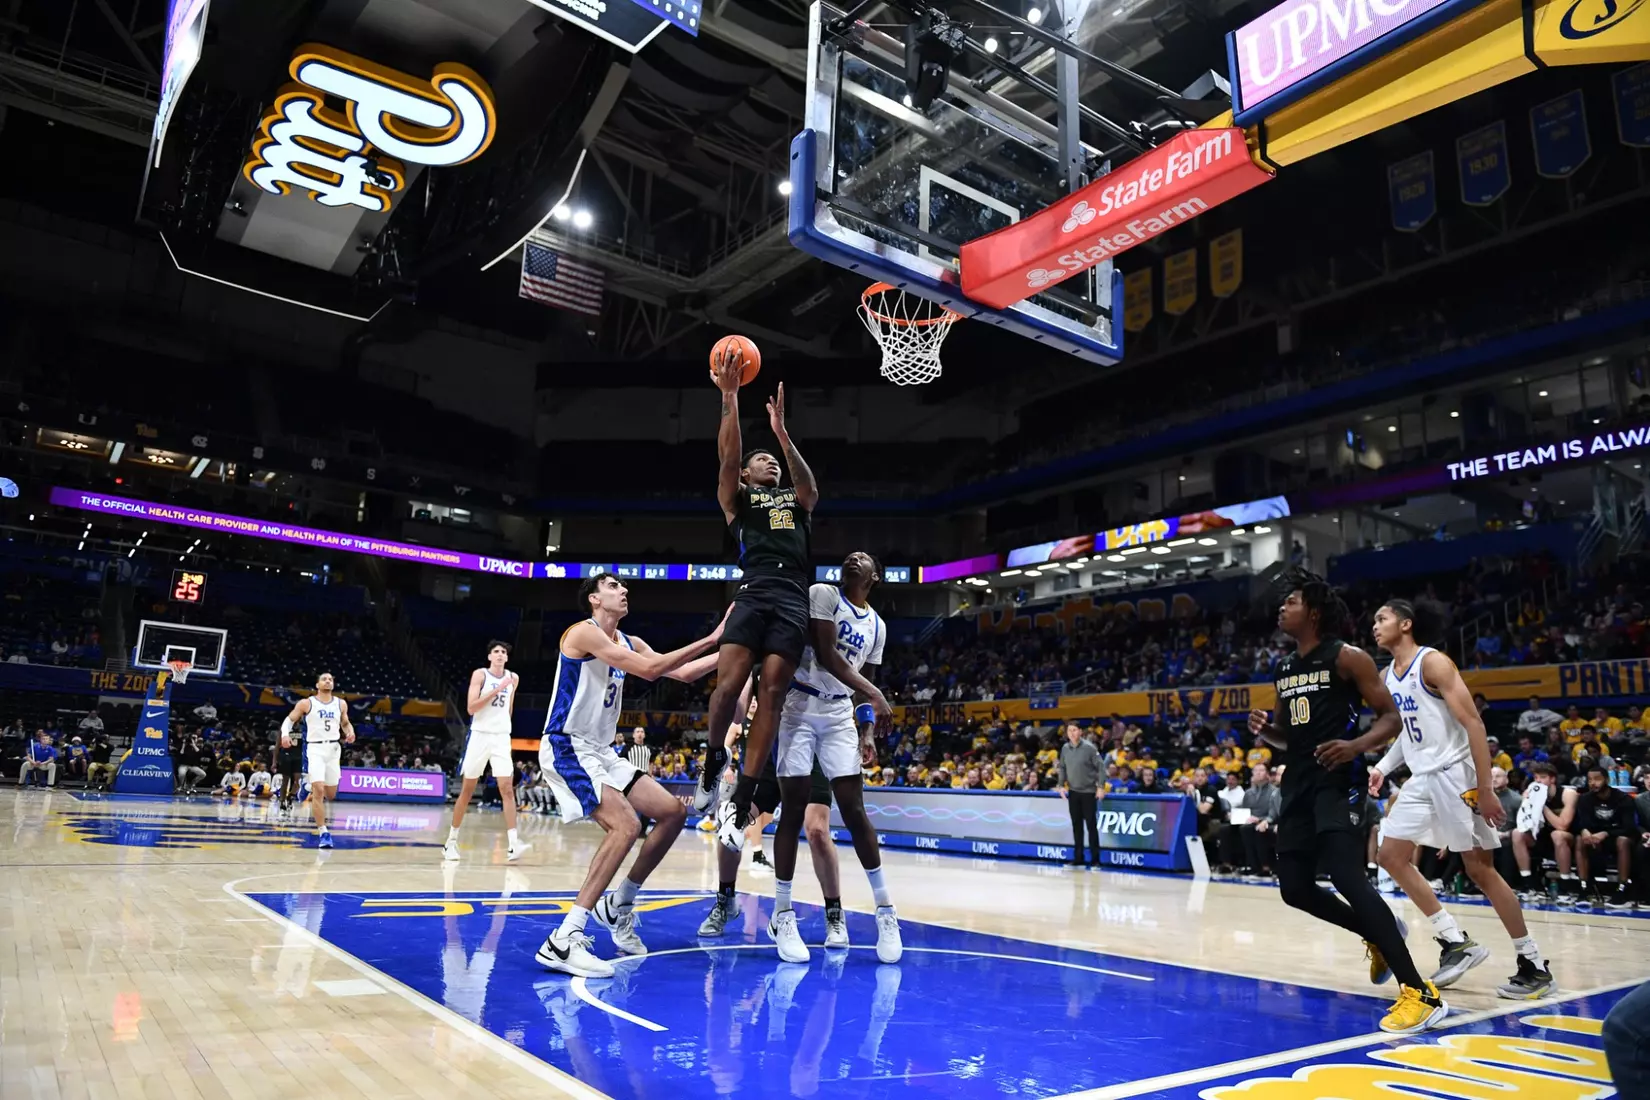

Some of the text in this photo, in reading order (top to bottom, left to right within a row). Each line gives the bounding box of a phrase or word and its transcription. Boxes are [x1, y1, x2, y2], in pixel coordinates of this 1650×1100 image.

[246, 46, 494, 212] Pitt
[1447, 427, 1650, 481] THE TEAM IS ALW
[768, 508, 796, 530] 22
[81, 496, 461, 564] THE OFFICIAL HEALTH CARE PROVIDER AND HEALTH PLAN OF THE PITTSBURGH PANTHERS
[479, 557, 523, 576] UPMC
[632, 568, 638, 576] 2
[700, 567, 727, 579] 3:48
[825, 569, 841, 581] 41
[175, 582, 199, 601] 25
[838, 620, 865, 650] Pitt
[91, 671, 118, 691] THE
[492, 694, 506, 708] 25
[1147, 687, 1250, 714] THE ZOO
[317, 709, 334, 719] Pitt
[1289, 696, 1311, 726] 10
[143, 727, 164, 739] Pitt
[324, 720, 331, 732] 5
[1403, 716, 1423, 744] 15
[137, 747, 165, 757] UPMC
[122, 769, 172, 779] CLEARVIEW
[350, 774, 398, 790] UPMC
[916, 836, 939, 849] UPMC
[972, 841, 999, 855] UPMC
[1037, 846, 1067, 860] UPMC
[1110, 851, 1144, 866] UPMC
